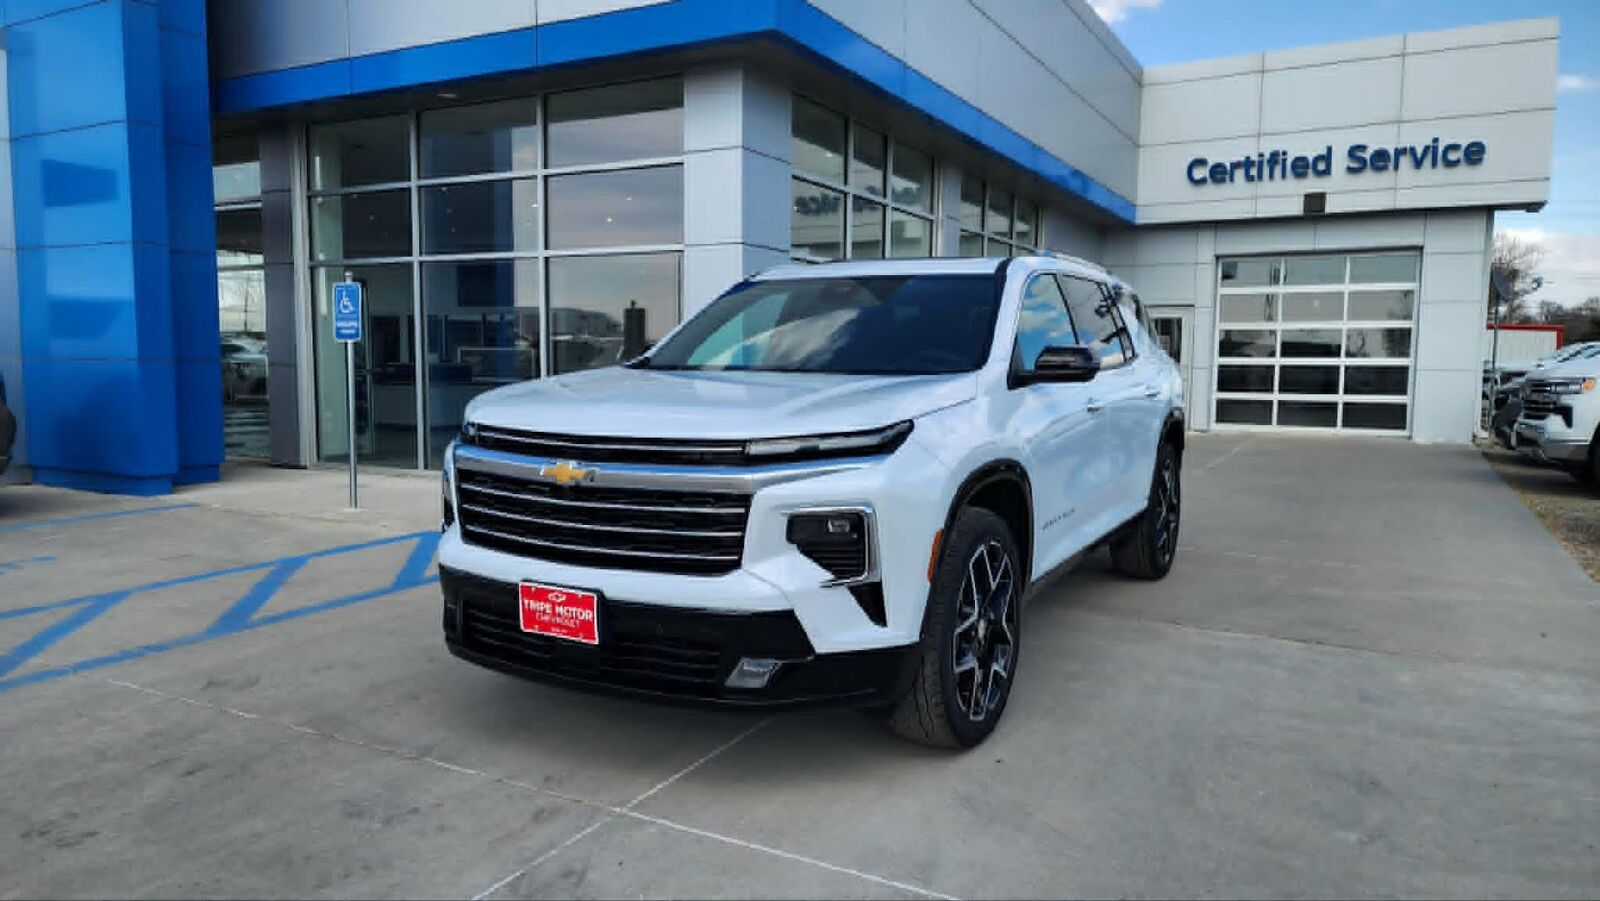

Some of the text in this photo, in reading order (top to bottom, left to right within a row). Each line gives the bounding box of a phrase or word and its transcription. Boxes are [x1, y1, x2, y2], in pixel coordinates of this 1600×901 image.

[1187, 137, 1487, 186] Certified Service
[555, 605, 593, 622] MOTOR
